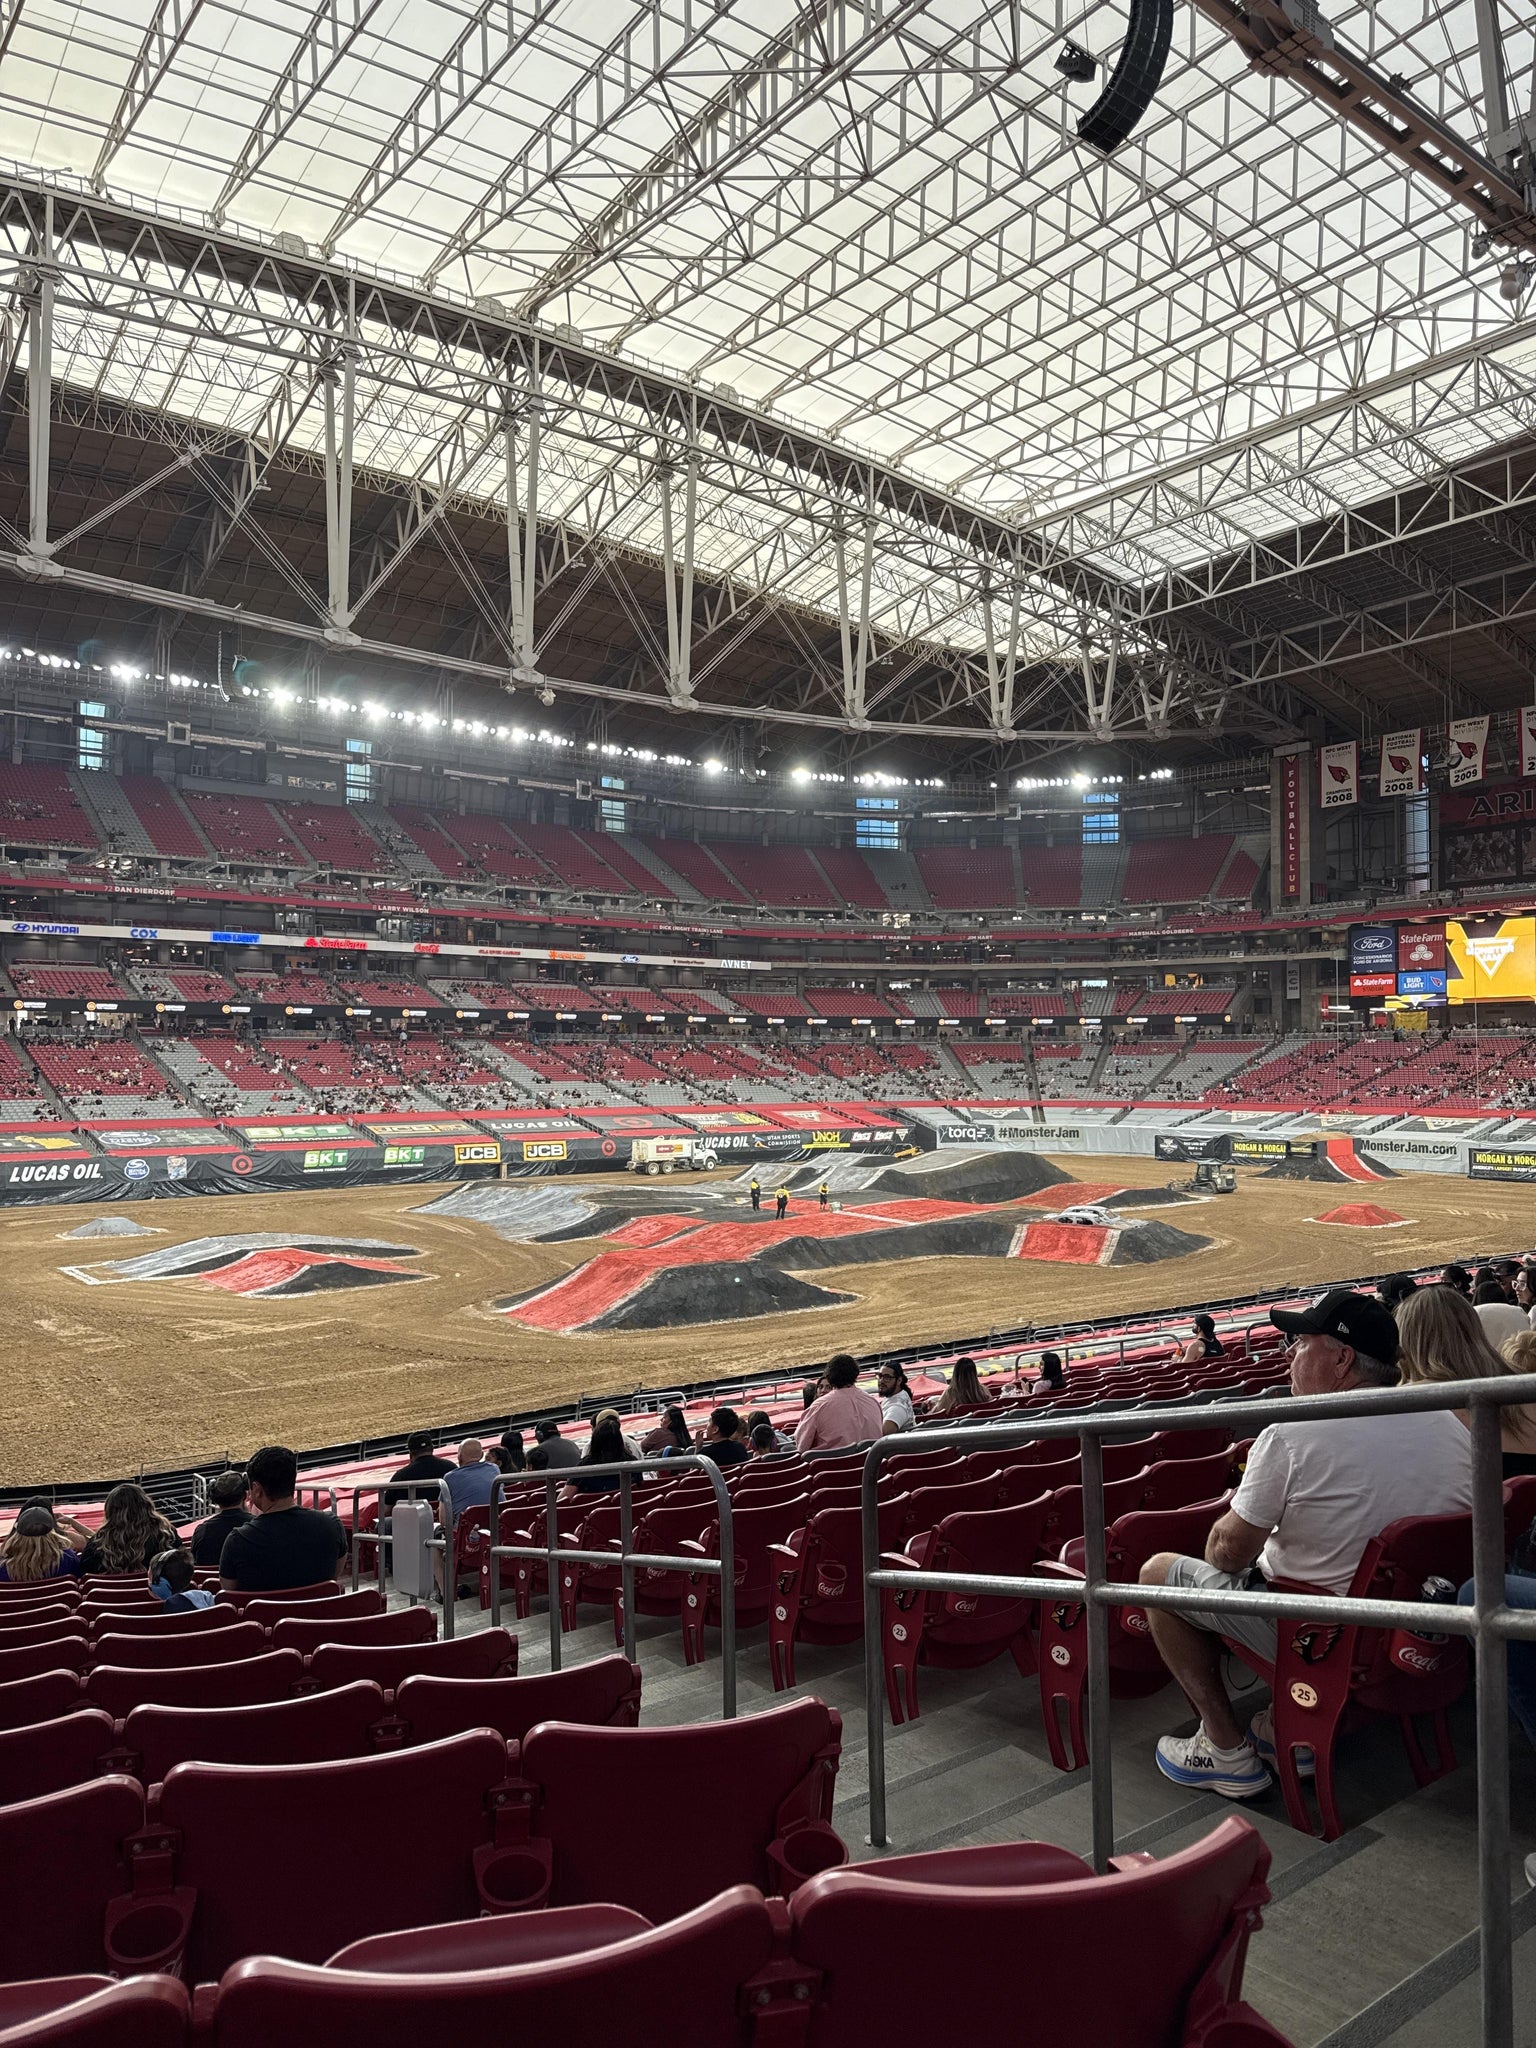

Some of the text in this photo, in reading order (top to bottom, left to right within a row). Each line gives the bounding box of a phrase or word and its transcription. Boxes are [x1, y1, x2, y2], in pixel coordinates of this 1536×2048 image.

[1454, 726, 1485, 735] DIVISION
[1386, 733, 1416, 741] NATIONAL
[1386, 739, 1416, 747] FOOTBALL
[1325, 750, 1352, 759] DIVISION
[1454, 769, 1478, 783] 2009
[1385, 782, 1414, 793] 2008
[1325, 793, 1353, 804] 2008
[134, 887, 175, 896] DIERDORF
[377, 904, 401, 912] LARRY
[402, 906, 429, 914] WILSON
[32, 924, 80, 934] HYUNDAI
[130, 928, 158, 939] COX
[212, 932, 260, 943] BUD LIGHT
[1361, 938, 1384, 949] Ford
[720, 960, 752, 969] AVNET
[812, 1131, 840, 1142] UNOH
[998, 1127, 1080, 1139] #MonsterJam
[527, 1145, 564, 1157] JCB
[1234, 1143, 1257, 1151] MORGAN
[1258, 1143, 1263, 1151] &
[1361, 1139, 1458, 1155] MonsterJam.com
[305, 1151, 347, 1167] BKT
[385, 1149, 424, 1163] BKT
[459, 1147, 498, 1160] JCB
[1476, 1153, 1506, 1163] MORGAN
[1507, 1155, 1513, 1164] &
[9, 1164, 71, 1182] LUCAS
[895, 1627, 904, 1637] 23
[1055, 1650, 1066, 1660] 24
[1297, 1688, 1311, 1702] 25
[1184, 1755, 1215, 1769] HOKA
